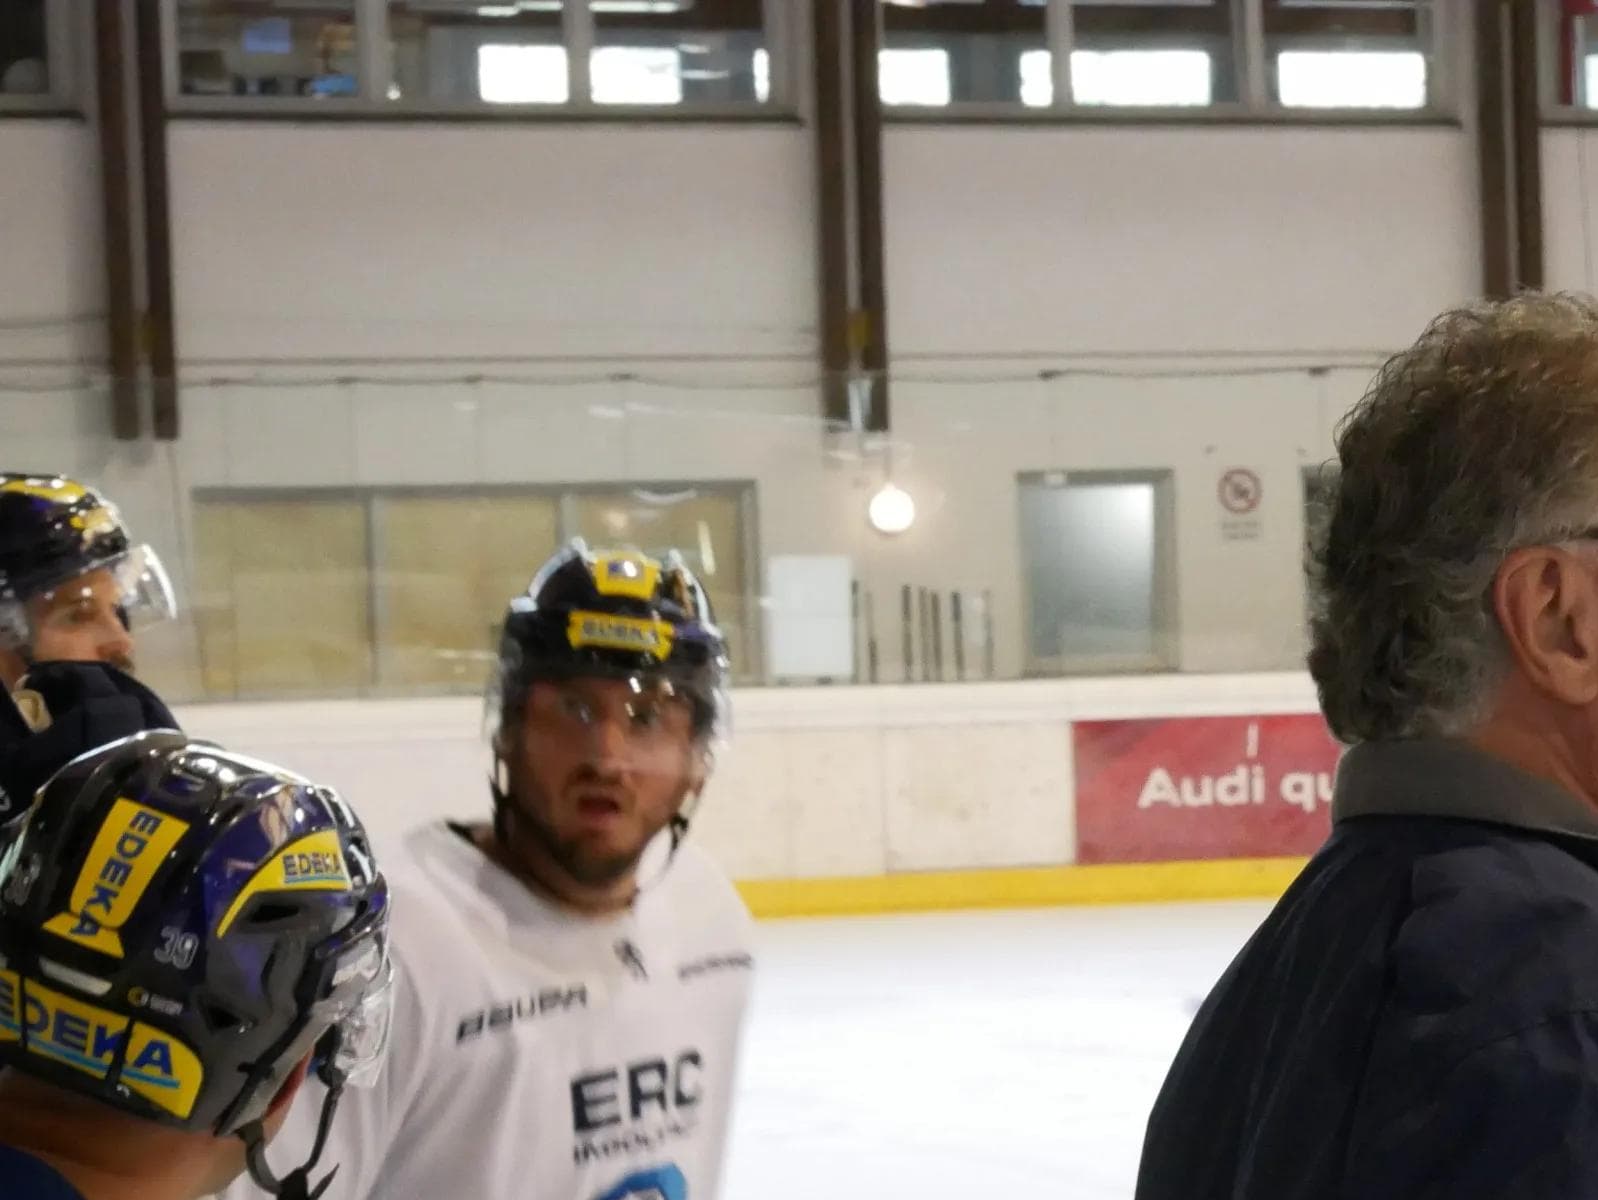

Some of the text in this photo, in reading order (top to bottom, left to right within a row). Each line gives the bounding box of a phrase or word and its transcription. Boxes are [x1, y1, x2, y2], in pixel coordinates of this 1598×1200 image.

[1138, 764, 1266, 809] Audi
[70, 810, 163, 938] EDEKA
[282, 853, 341, 877] EDEKA
